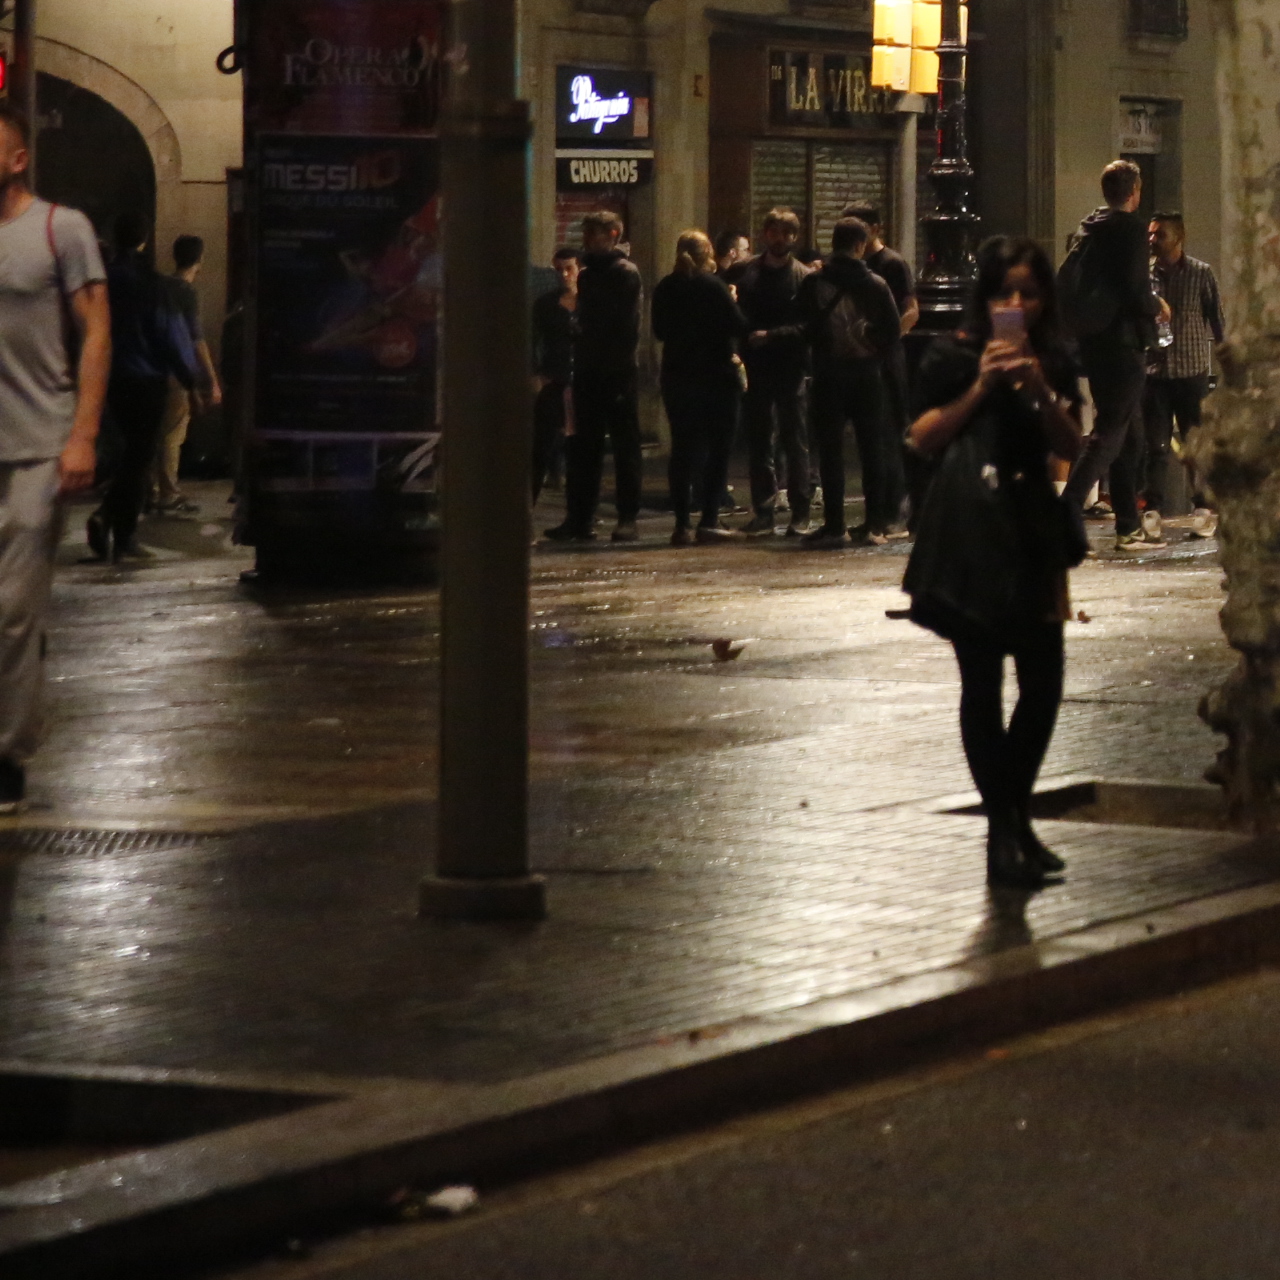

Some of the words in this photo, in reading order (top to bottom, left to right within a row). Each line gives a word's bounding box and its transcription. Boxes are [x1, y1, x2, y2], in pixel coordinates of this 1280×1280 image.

[305, 38, 402, 65] OPERA
[283, 53, 419, 87] FLAMENCO
[789, 66, 821, 110] LA
[570, 160, 638, 183] CHURROS
